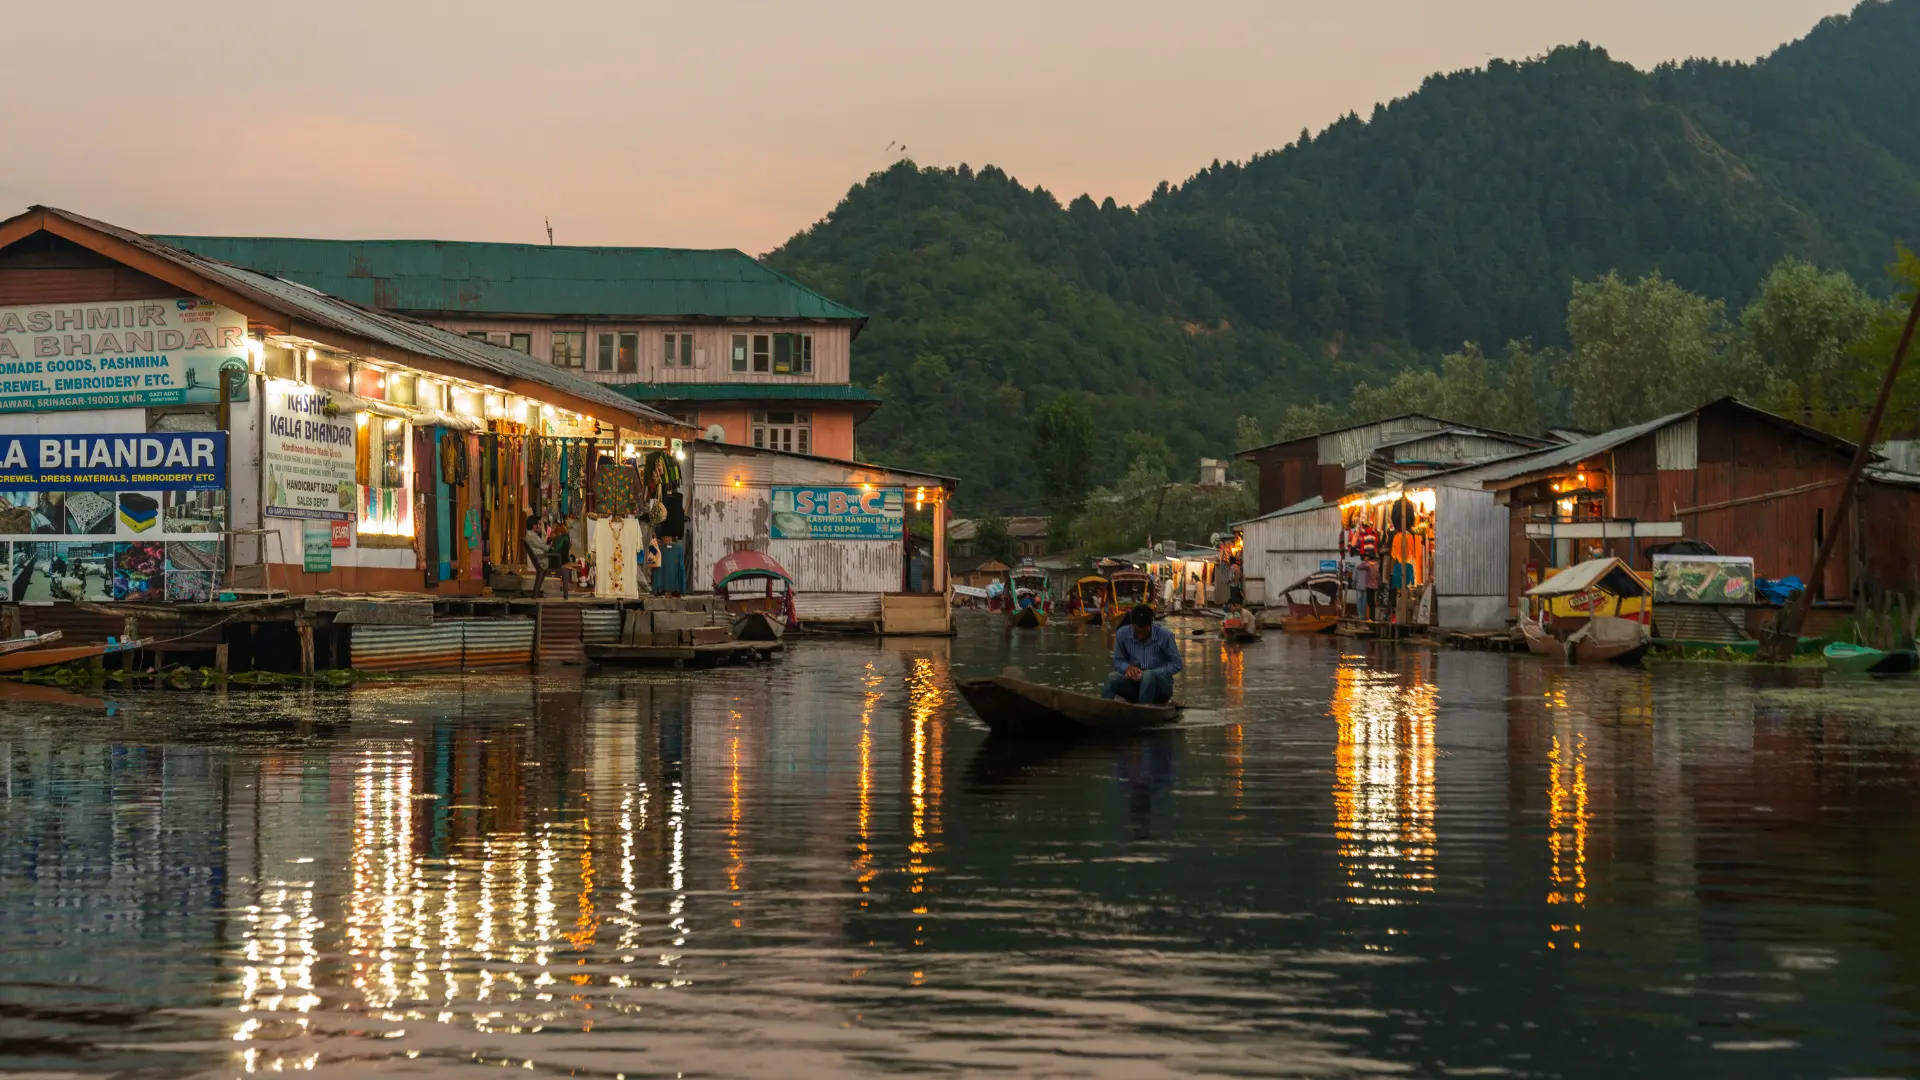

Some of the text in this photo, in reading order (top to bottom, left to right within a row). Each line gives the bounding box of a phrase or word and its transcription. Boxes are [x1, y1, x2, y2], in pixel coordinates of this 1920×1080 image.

[34, 327, 244, 358] BHANDAR
[47, 359, 96, 372] GOODS,
[100, 355, 169, 370] PASHMINA
[55, 375, 140, 390] EMBROIDERY
[145, 374, 174, 386] ETC.
[38, 395, 119, 407] SRINAGAR-190003
[270, 414, 352, 447] KALLA BHANDAR
[40, 438, 215, 468] BHANDAR
[74, 474, 128, 483] MATERIALS,
[132, 474, 193, 482] EMBROIDERY
[286, 479, 338, 494] HANDICRAFT BAZAR
[297, 496, 329, 507] SALES DEPOT
[807, 515, 901, 524] KASHMIR HANDICRAFTS
[808, 525, 862, 533] SALES DEPOT.
